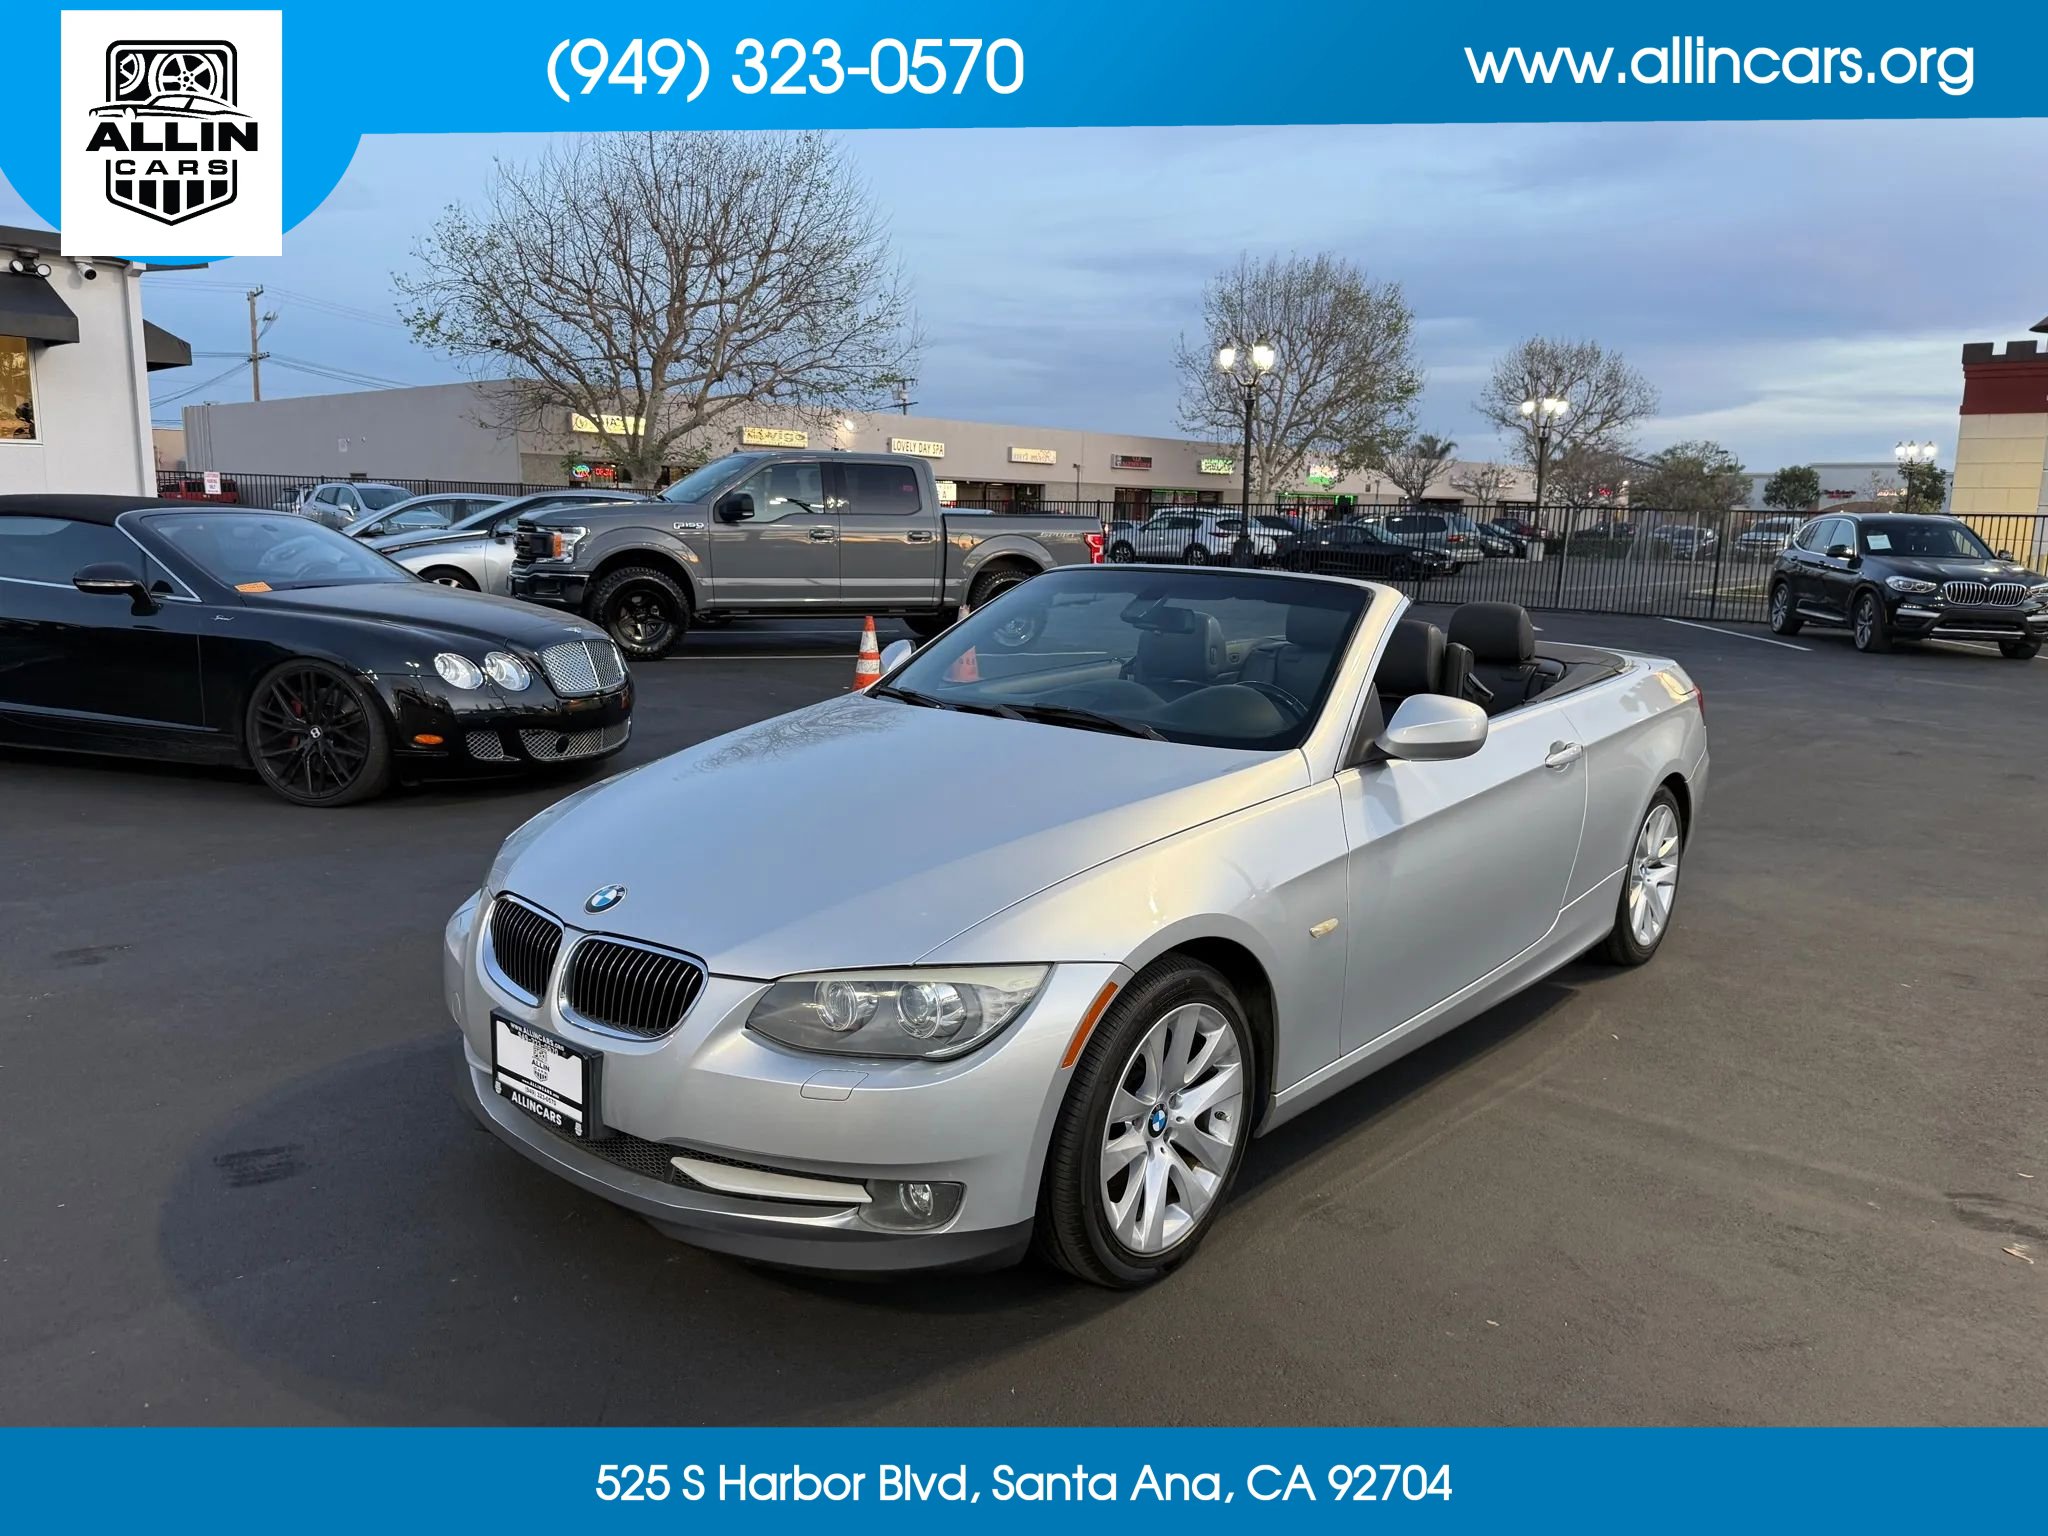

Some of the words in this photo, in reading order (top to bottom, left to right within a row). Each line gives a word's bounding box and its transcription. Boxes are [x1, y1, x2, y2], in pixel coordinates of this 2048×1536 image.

[893, 440, 917, 453] LOVELY
[918, 442, 932, 454] DAY
[932, 443, 944, 456] SPA
[511, 1091, 563, 1126] ALLINCARS
